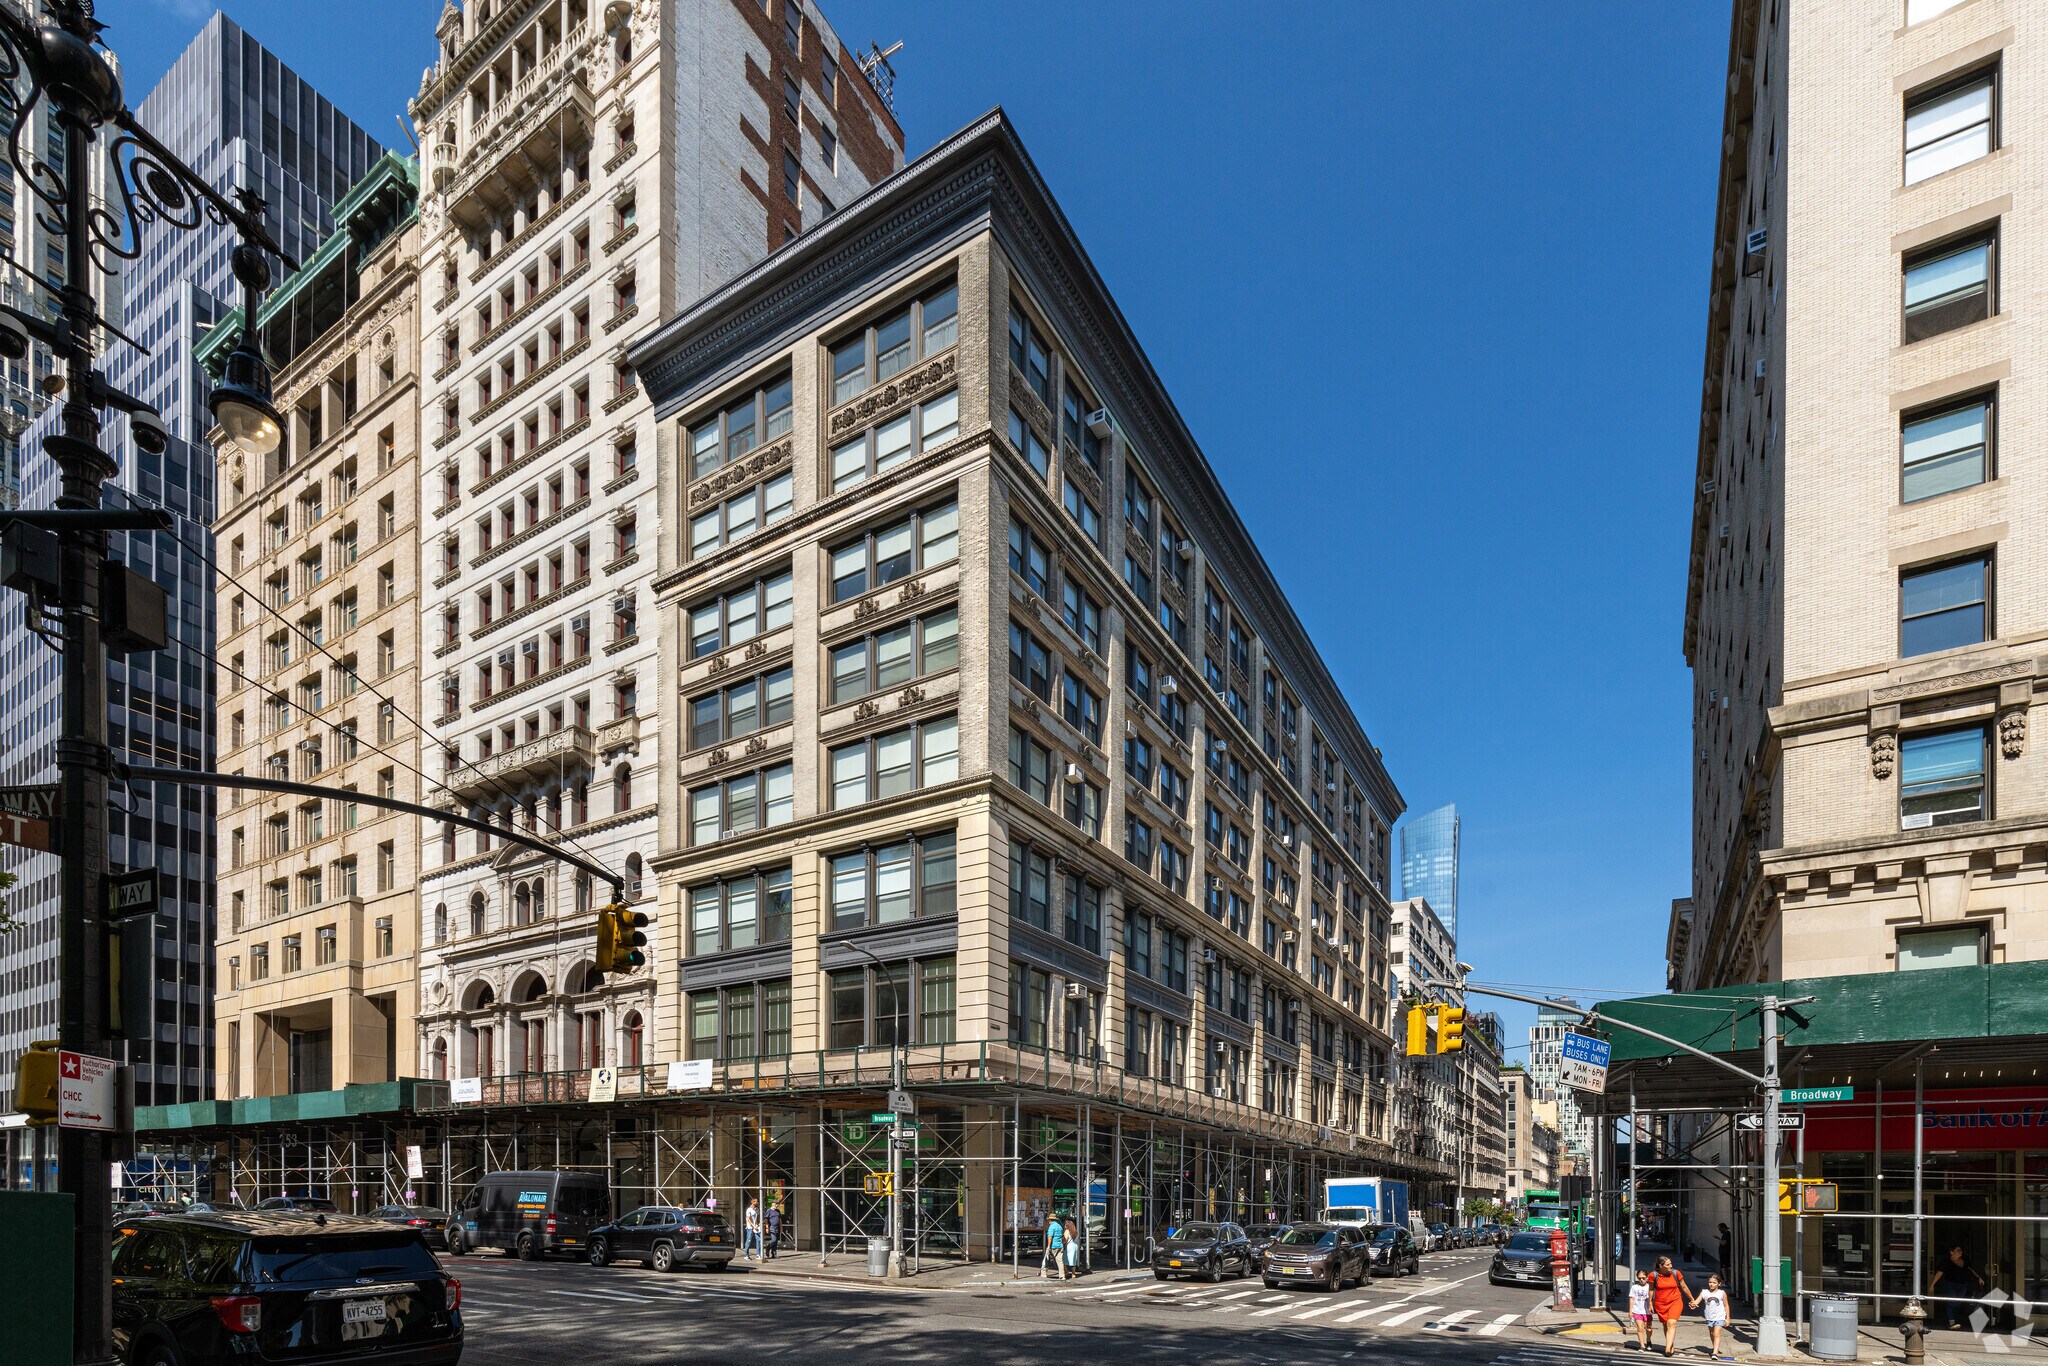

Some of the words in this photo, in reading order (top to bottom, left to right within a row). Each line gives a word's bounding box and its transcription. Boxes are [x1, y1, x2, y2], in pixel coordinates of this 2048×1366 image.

[2, 791, 56, 817] WAY
[4, 806, 41, 819] DISTRICT
[1577, 1038, 1590, 1049] BUS
[1592, 1043, 1608, 1055] LANE
[1566, 1047, 1588, 1060] BUSES
[1591, 1053, 1606, 1065] ONLY
[82, 1058, 110, 1070] Authorized
[82, 1065, 104, 1076] Vehicles
[1573, 1062, 1588, 1073] 7AM
[1592, 1067, 1604, 1078] 6PM
[82, 1073, 94, 1083] Only
[1573, 1074, 1588, 1085] MON
[1591, 1078, 1602, 1089] FRI
[62, 1090, 83, 1102] CHCC
[1790, 1090, 1842, 1100] Broadway
[874, 1115, 893, 1123] Broadway
[1922, 1106, 1998, 1129] Bank
[2000, 1105, 2035, 1128] of
[847, 1125, 864, 1140] TD
